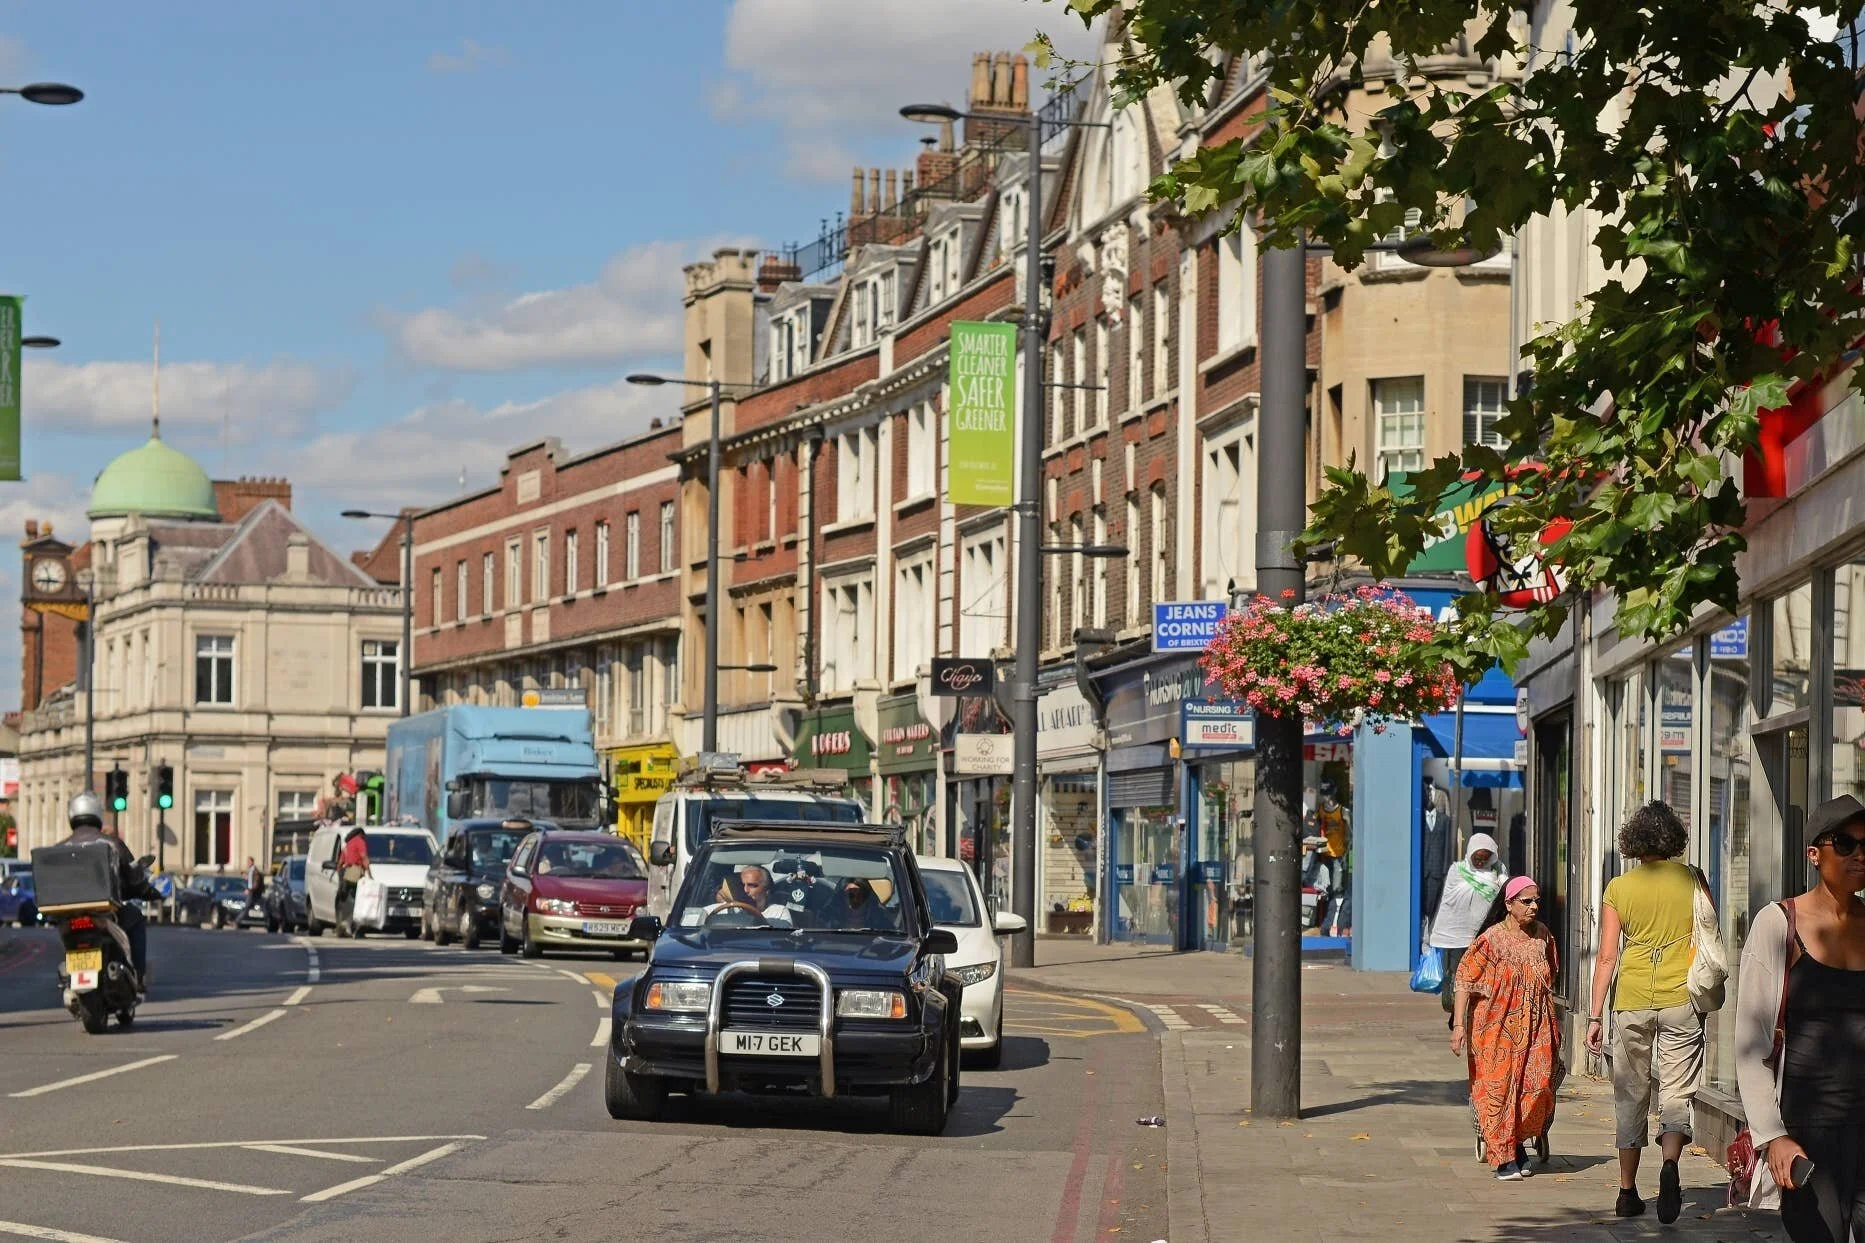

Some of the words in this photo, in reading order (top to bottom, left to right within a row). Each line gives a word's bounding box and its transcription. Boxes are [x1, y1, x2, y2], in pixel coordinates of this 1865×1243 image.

[957, 332, 1008, 356] SMARTER
[957, 355, 1008, 377] CLEANER
[957, 376, 1006, 409] SAFER
[956, 408, 1007, 432] GREENER
[1165, 605, 1217, 620] JEANS
[1181, 639, 1212, 647] BRIXTO
[1193, 705, 1231, 714] NURSING
[1202, 722, 1237, 733] medic
[78, 971, 91, 985] L
[736, 1035, 763, 1051] M17
[768, 1036, 802, 1052] GEK
